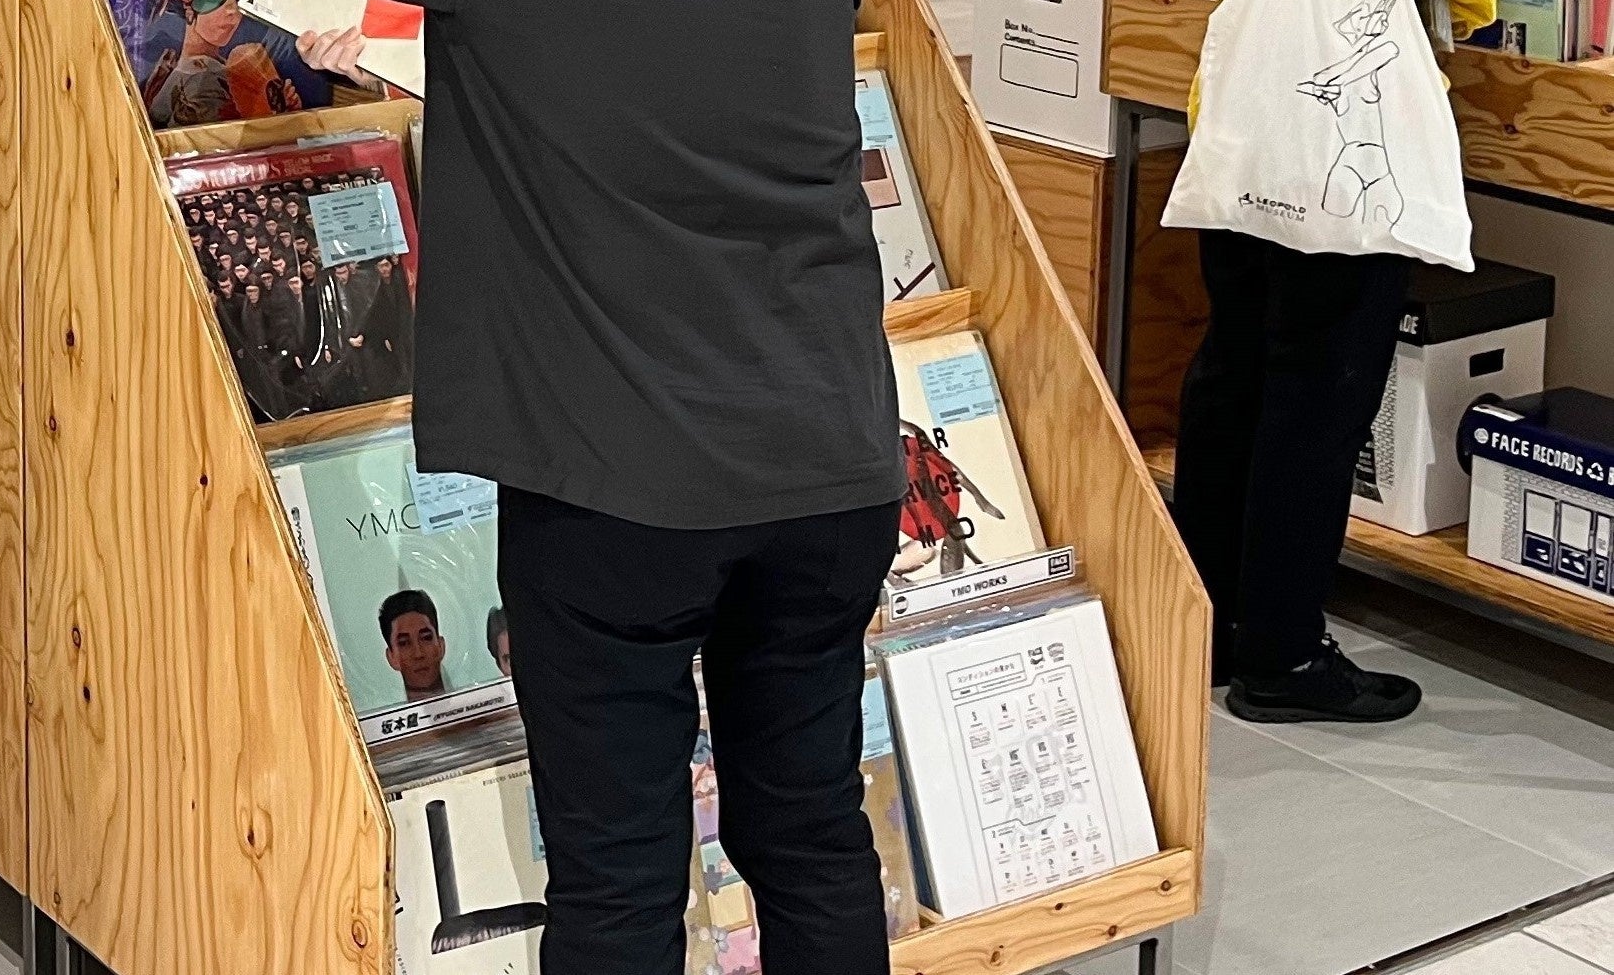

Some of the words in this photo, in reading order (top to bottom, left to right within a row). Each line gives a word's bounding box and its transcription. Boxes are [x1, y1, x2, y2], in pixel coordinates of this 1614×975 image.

[1256, 197, 1306, 214] LEOPOLD
[1256, 204, 1305, 222] MUSEUM
[1491, 432, 1530, 458] FACE
[1533, 443, 1584, 476] RECORDS
[951, 583, 972, 597] YMO
[974, 575, 1008, 594] WORKS
